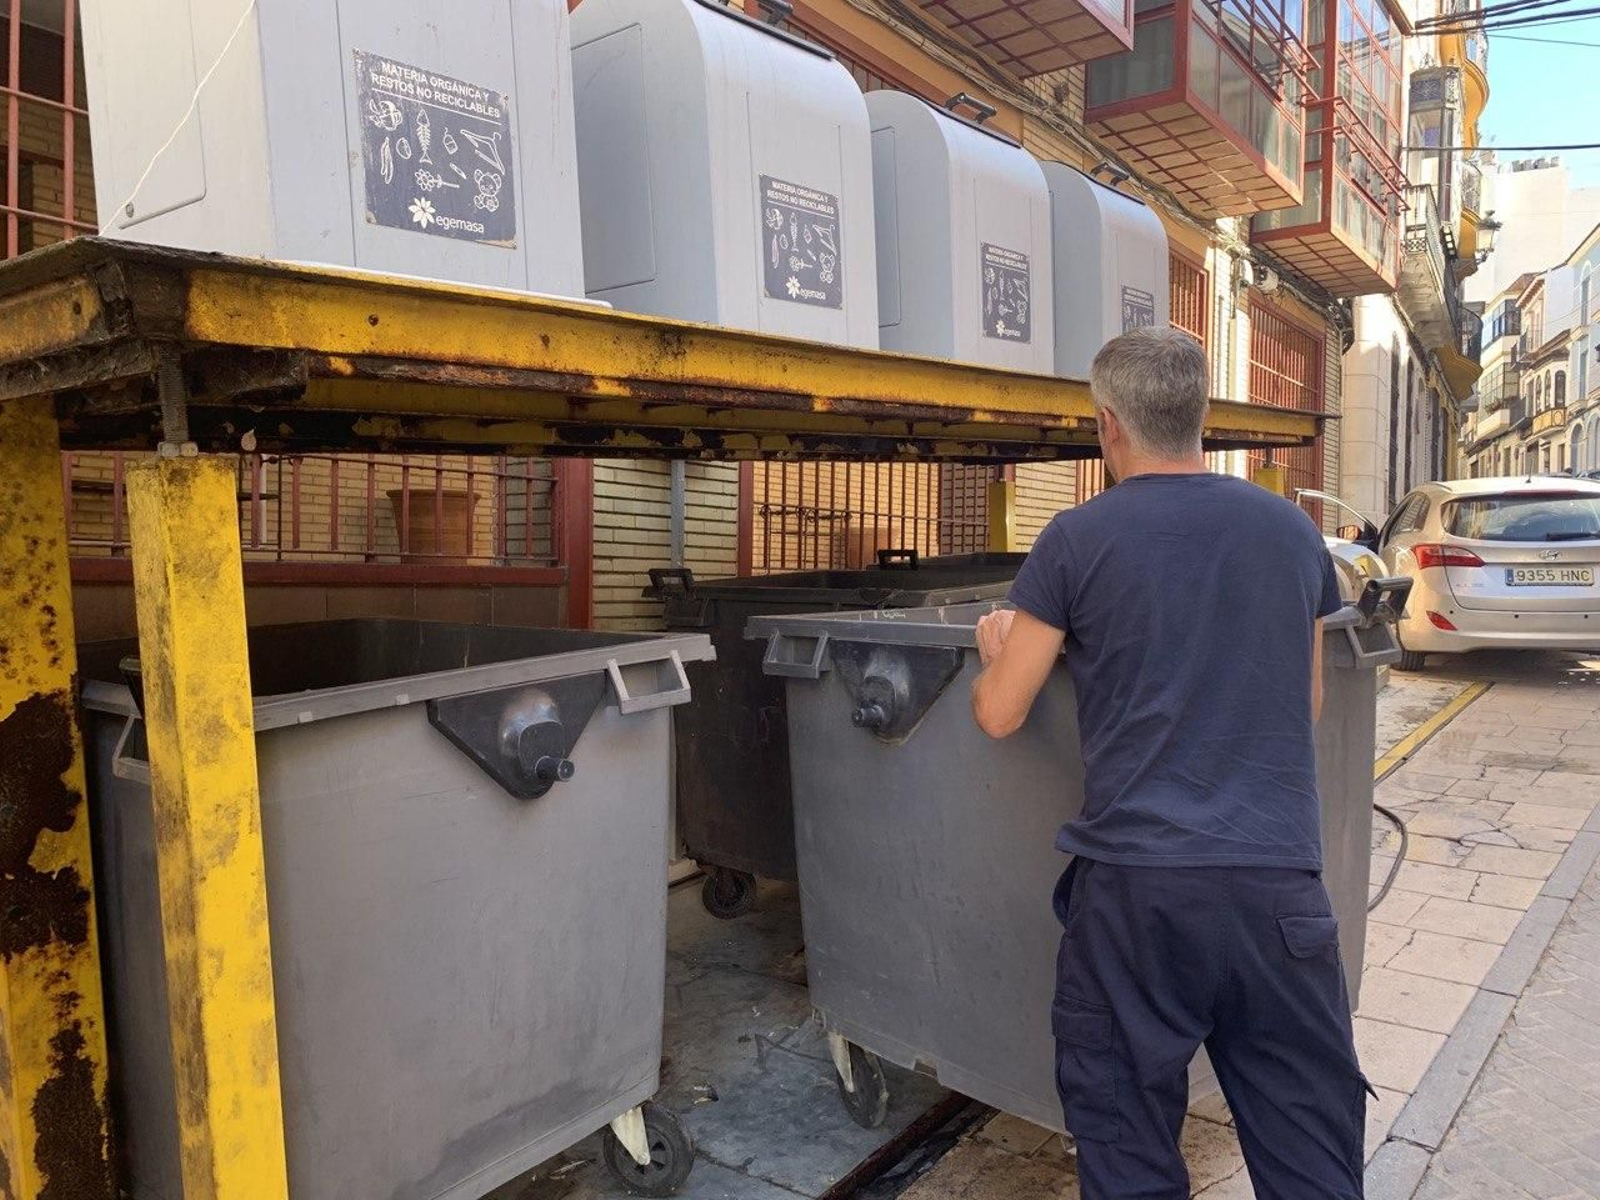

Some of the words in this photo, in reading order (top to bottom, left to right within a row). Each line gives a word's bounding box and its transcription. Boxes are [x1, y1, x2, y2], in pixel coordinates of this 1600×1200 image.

[370, 72, 415, 94] RESTOS
[416, 85, 432, 99] NO
[434, 92, 500, 118] RECICLABLES
[381, 61, 428, 86] MATERIA
[430, 76, 482, 100] ORGÁNICA
[483, 92, 490, 102] Y
[435, 215, 485, 233] egemasa
[1516, 570, 1556, 581] 9355
[1560, 570, 1590, 581] HNC
